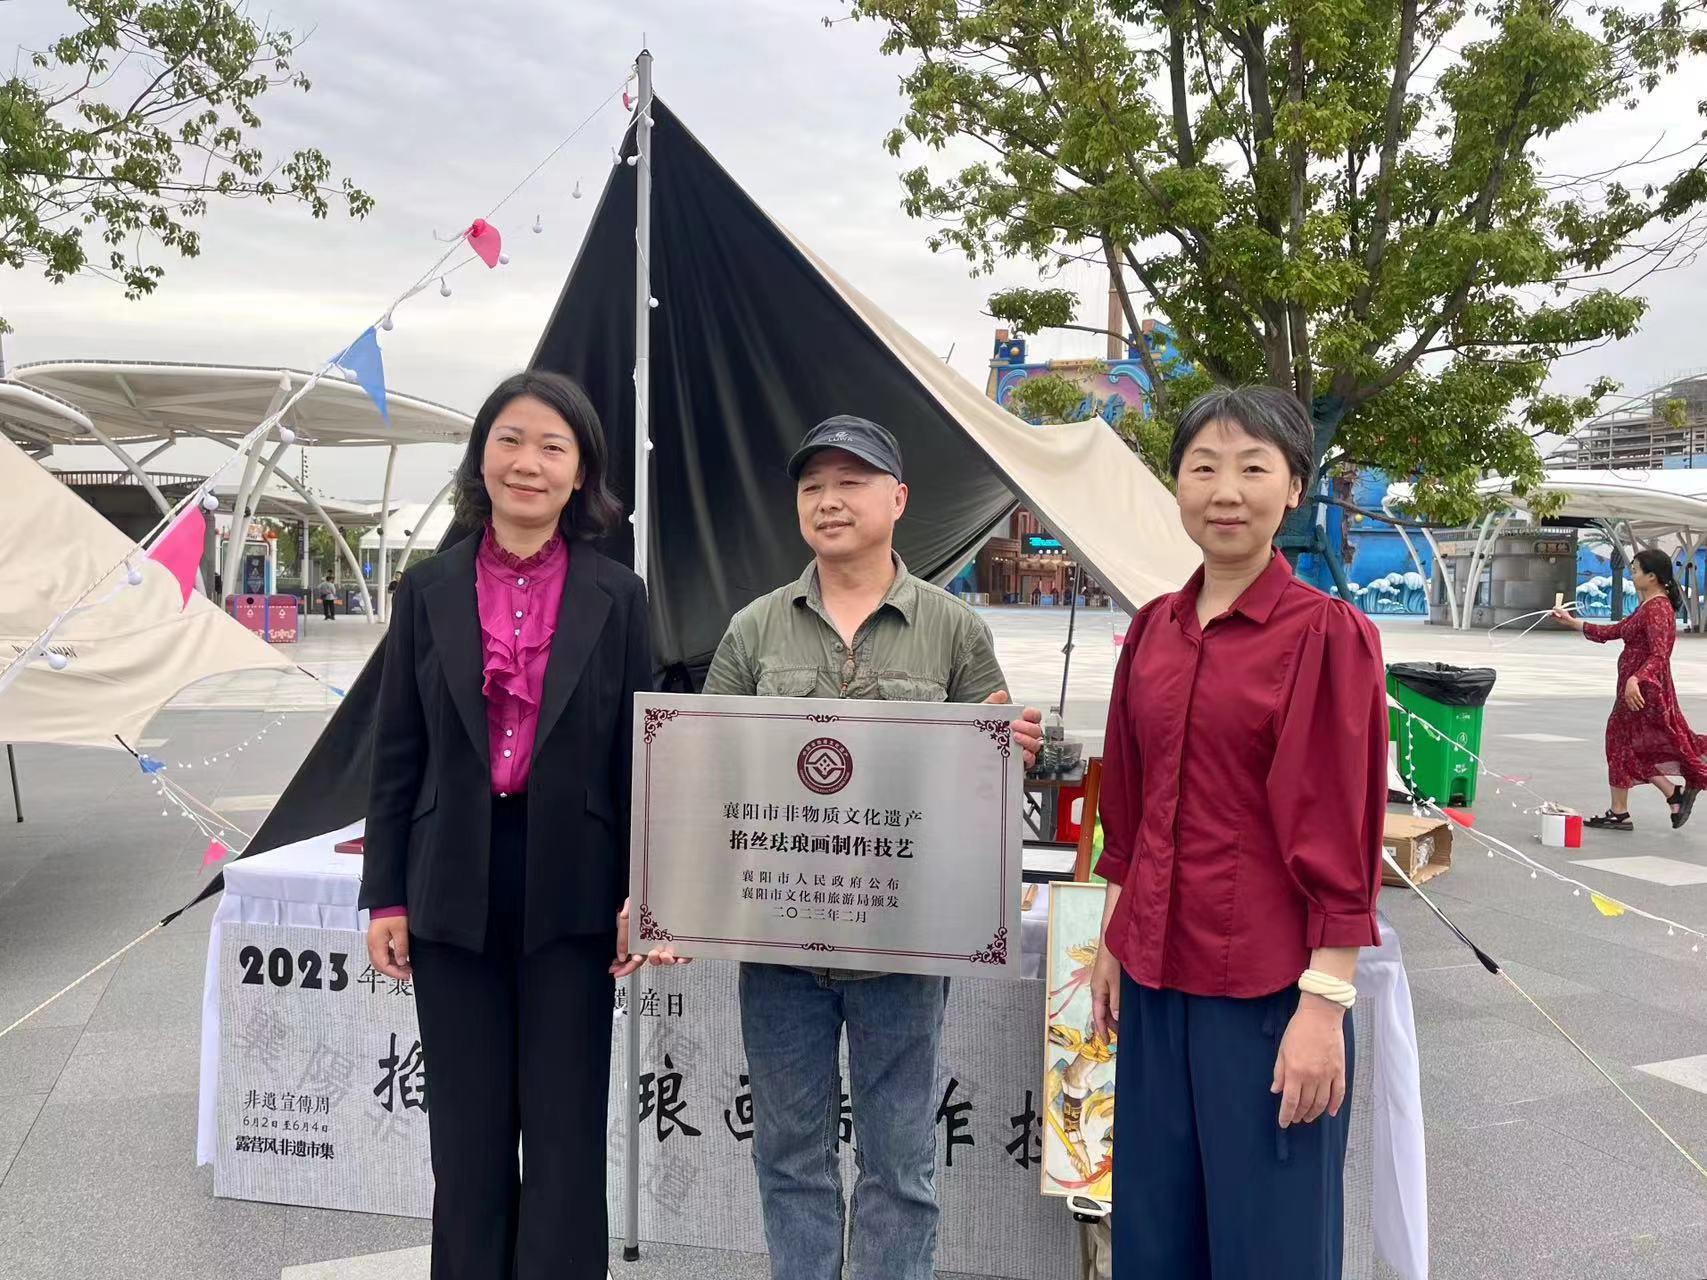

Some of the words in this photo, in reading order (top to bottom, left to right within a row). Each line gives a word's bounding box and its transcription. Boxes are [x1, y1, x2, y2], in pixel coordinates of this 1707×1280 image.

[722, 802, 922, 827] 襄阳市非物质文化遗产
[730, 830, 914, 858] 掐丝珐琅画制作技艺
[742, 870, 899, 891] 襄阳市人民政府公布
[742, 887, 899, 908] 襄阳市文化和旅游局颁发
[235, 1135, 335, 1160] 露营风非遗市集
